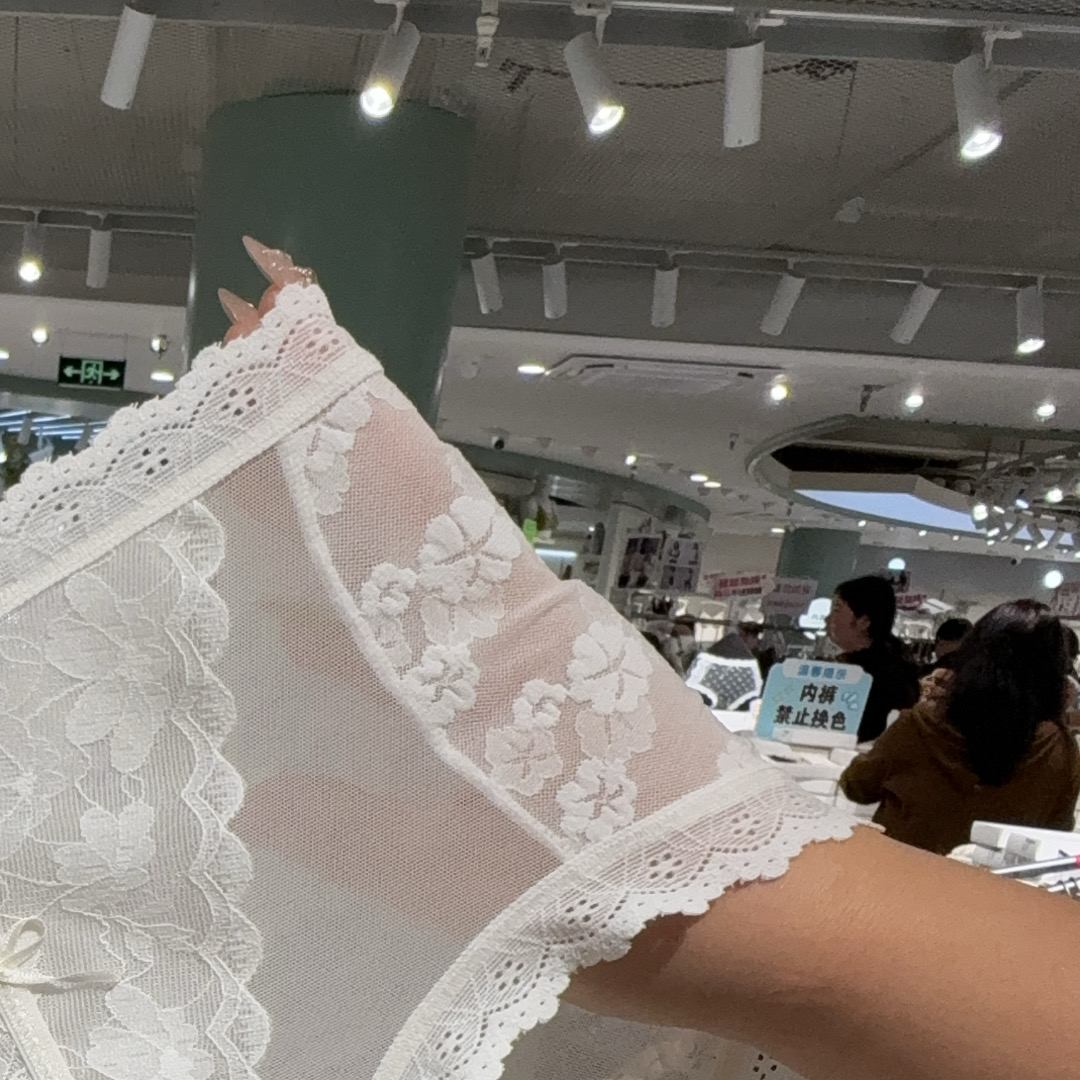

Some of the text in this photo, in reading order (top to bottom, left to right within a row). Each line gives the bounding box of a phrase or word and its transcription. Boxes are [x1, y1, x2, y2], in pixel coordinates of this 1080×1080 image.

[799, 683, 839, 705] 内裤
[773, 704, 846, 732] 禁止换色
